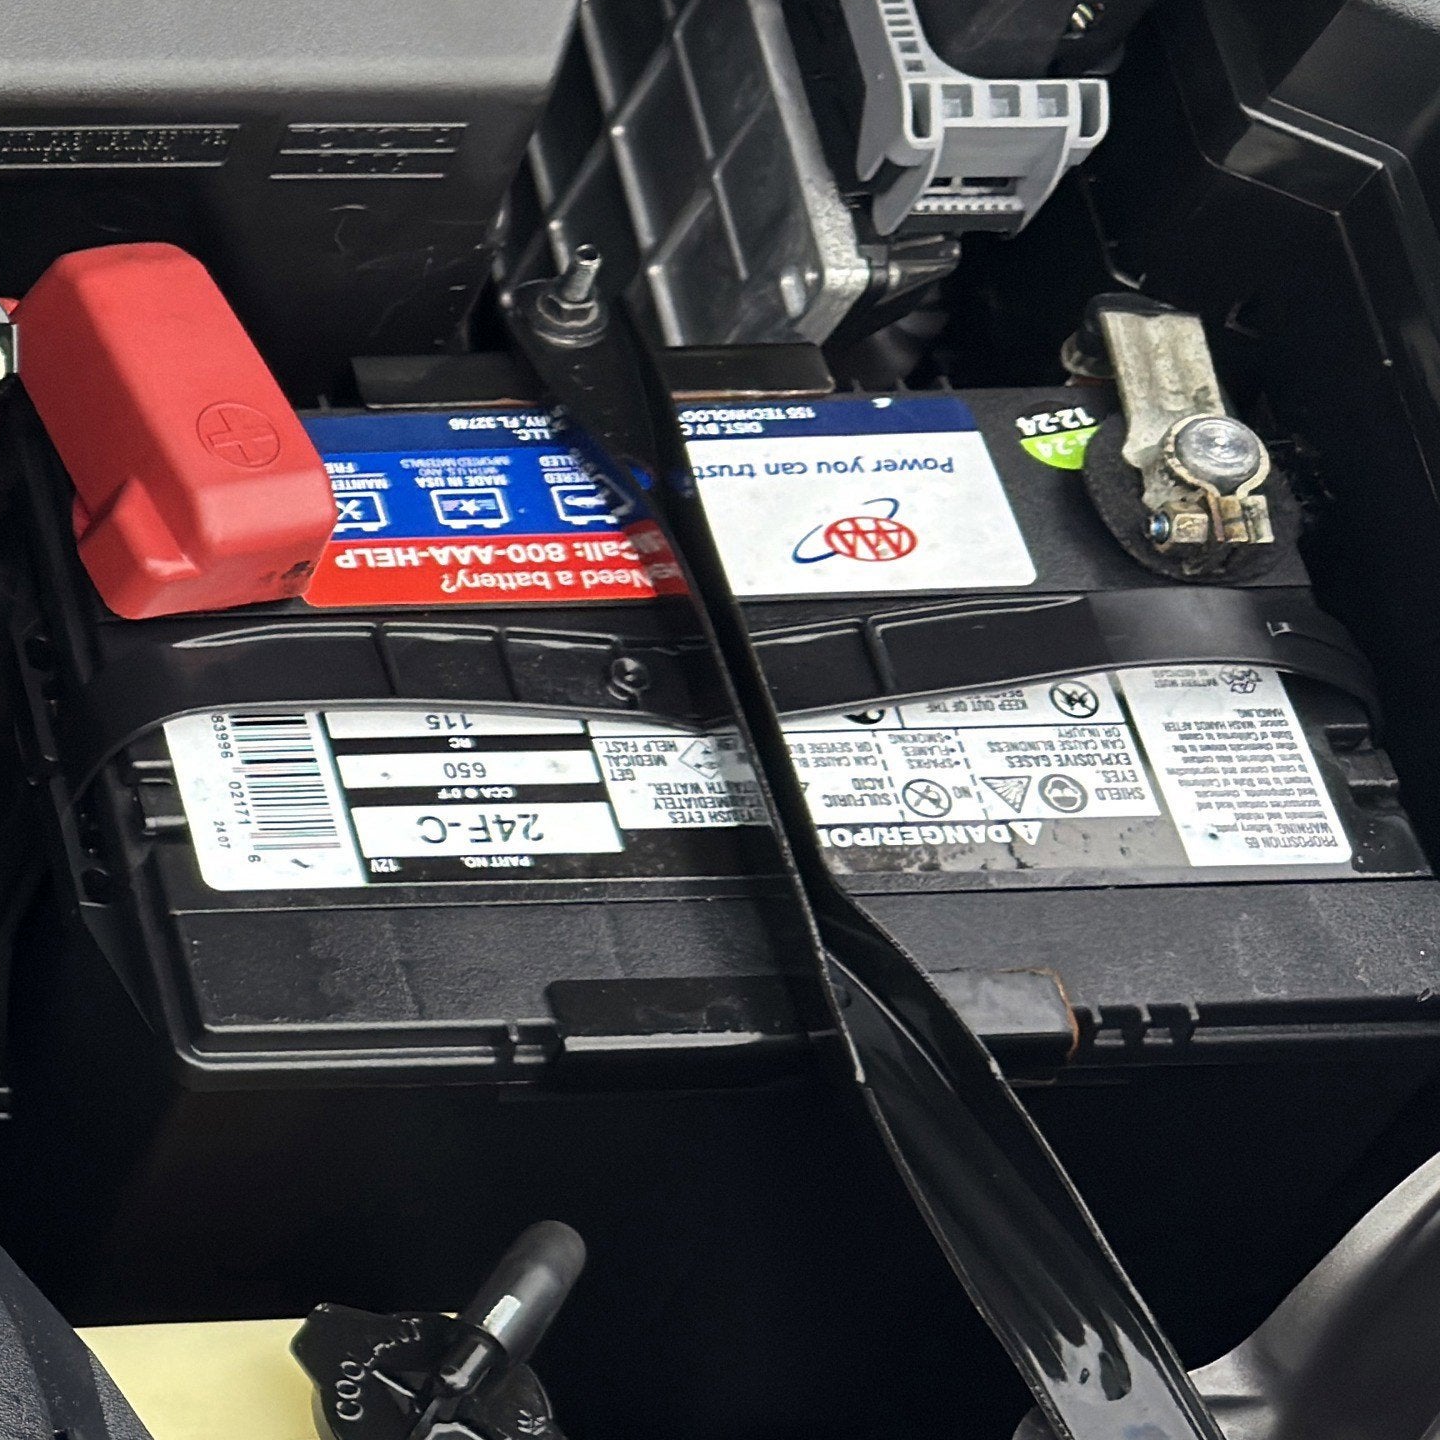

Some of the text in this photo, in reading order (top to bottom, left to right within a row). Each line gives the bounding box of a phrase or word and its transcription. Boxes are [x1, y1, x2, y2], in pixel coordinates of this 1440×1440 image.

[1015, 407, 1095, 435] 12-24
[696, 423, 720, 435] BY
[764, 461, 809, 477] can
[816, 455, 864, 476] you
[874, 456, 954, 477] Power
[415, 475, 507, 489] MADE IN USA
[830, 518, 908, 557] AAA
[334, 543, 566, 568] 800-AAA-HELP
[440, 568, 651, 593] Need a battery?
[951, 701, 968, 712] OF
[970, 700, 995, 711] OUT
[998, 699, 1028, 711] KEEP
[425, 715, 473, 730] 115
[1102, 727, 1121, 738] OR
[448, 737, 475, 748] RC
[599, 740, 677, 753] HELP FAST.
[808, 743, 853, 754] SEVERE
[987, 738, 1126, 753] CAN CAUSE BLINDNESS
[603, 754, 667, 767] MEDICAL
[812, 756, 852, 768] CAUSE
[854, 755, 877, 767] CAN
[1005, 752, 1131, 768] EXPLOSIVE GASES
[443, 762, 486, 779] 650
[610, 768, 635, 781] GET
[1095, 770, 1138, 783] EYES.
[647, 783, 703, 795] WATER.
[851, 778, 883, 790] ACID
[479, 787, 516, 798] CCA
[1094, 787, 1145, 801] SHIELD
[822, 794, 891, 807] SULFURIC
[228, 781, 251, 825] 02171
[248, 854, 261, 863] 6
[668, 811, 705, 823] EYES
[415, 813, 545, 844] 24F-C
[1276, 822, 1332, 834] WARNING:
[816, 825, 1012, 849] DANGER/POI
[1245, 835, 1338, 848] PROPOSITION 65
[370, 859, 399, 873] 12V
[460, 854, 531, 868] PART NO.
